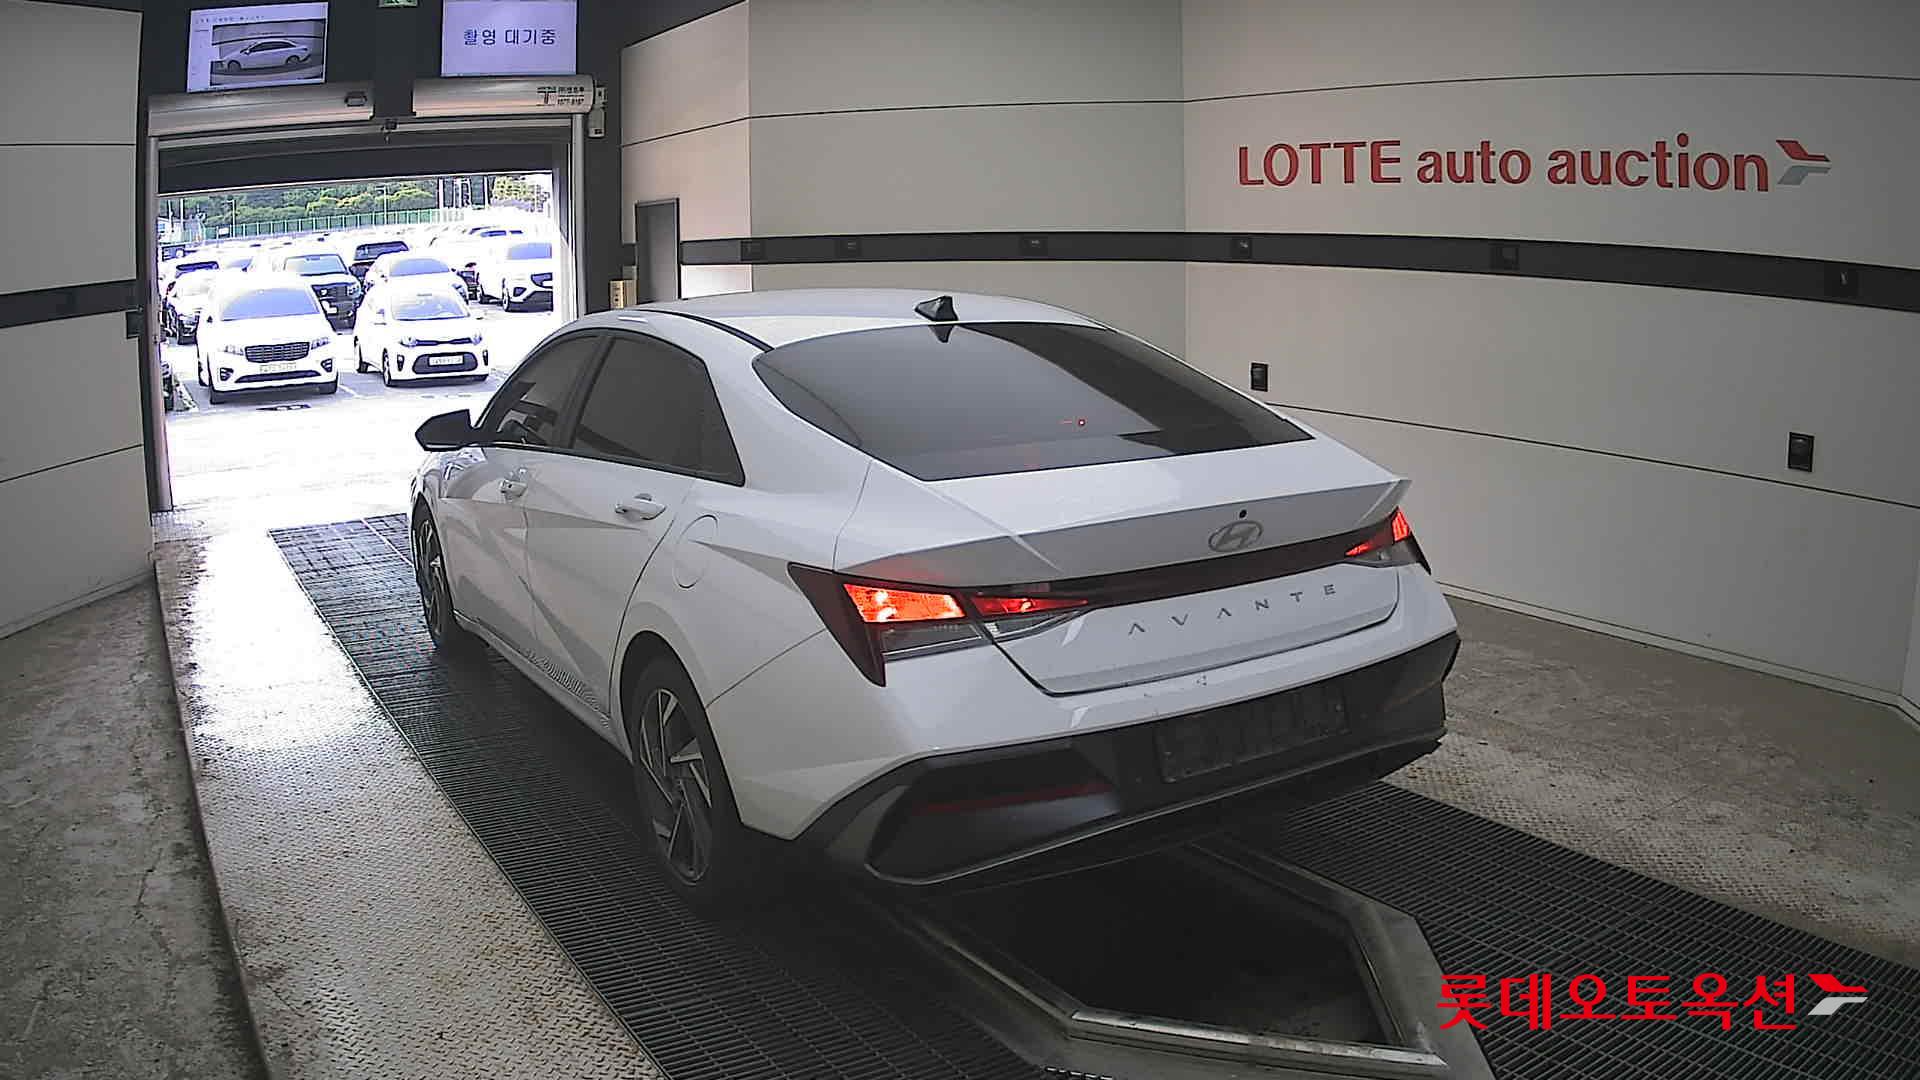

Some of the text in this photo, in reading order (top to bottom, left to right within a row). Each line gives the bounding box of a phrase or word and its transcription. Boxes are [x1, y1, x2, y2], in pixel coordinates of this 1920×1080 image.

[504, 29, 556, 46] 대기중
[1238, 133, 1769, 191] LOTTE auto auction
[1128, 584, 1337, 636] AVANTE
